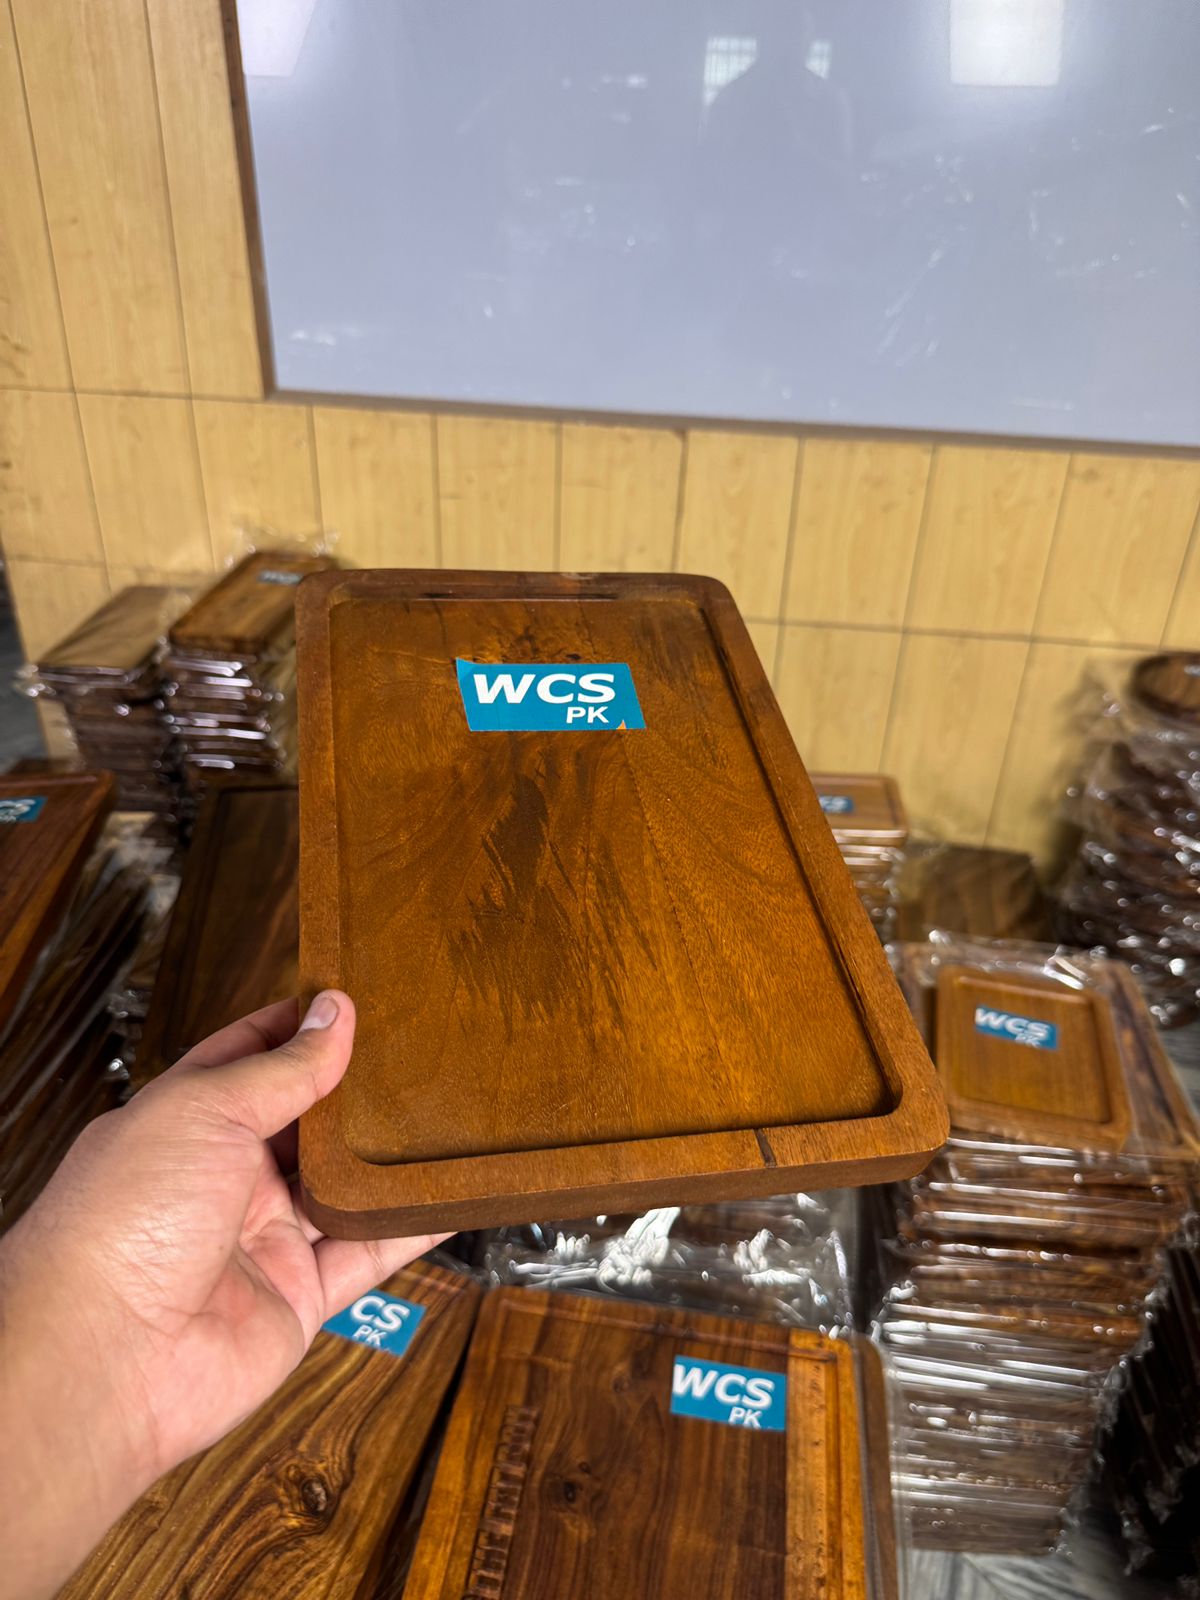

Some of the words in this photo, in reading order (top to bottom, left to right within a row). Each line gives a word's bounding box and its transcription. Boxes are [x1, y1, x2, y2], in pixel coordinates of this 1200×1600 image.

[473, 673, 616, 704] WCS
[566, 706, 610, 724] PK
[0, 799, 36, 817] CS
[975, 1008, 1050, 1041] WCS
[350, 1295, 410, 1331] CS
[352, 1324, 386, 1347] PK
[673, 1363, 775, 1409] WCS
[728, 1406, 762, 1429] PK
